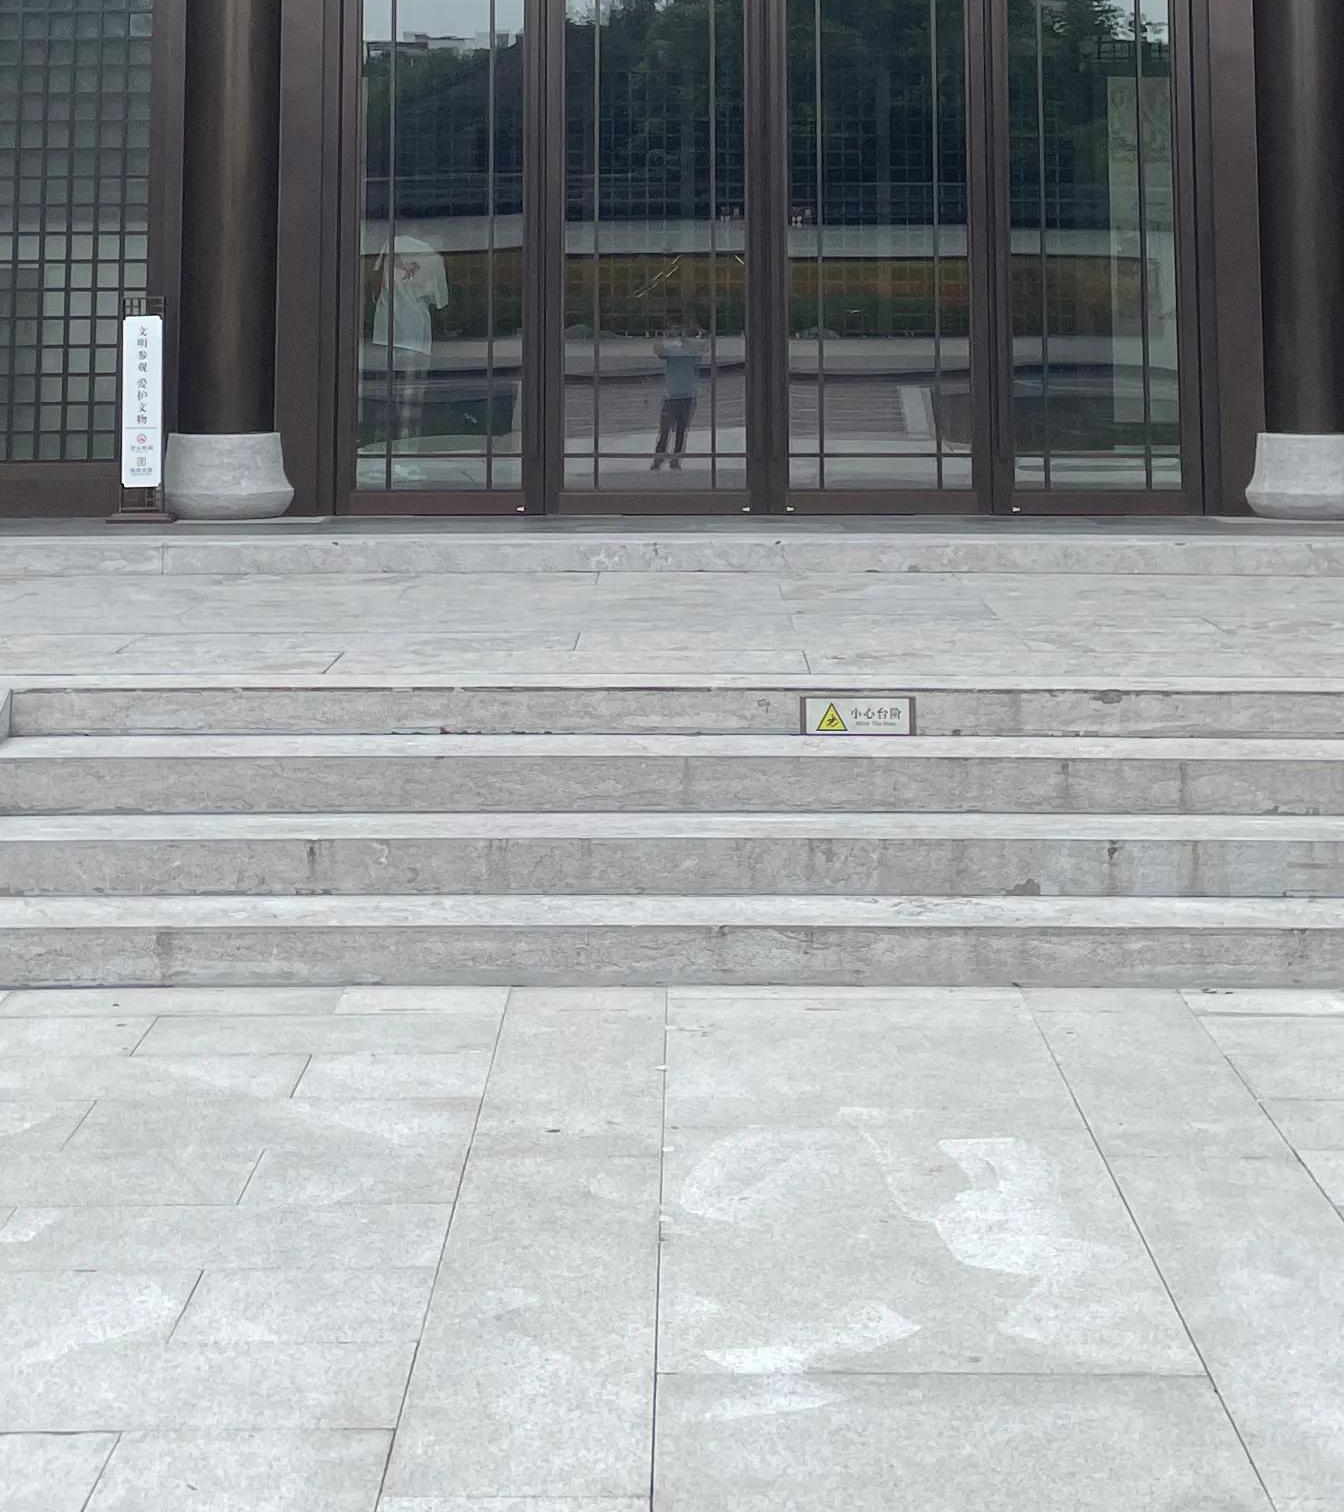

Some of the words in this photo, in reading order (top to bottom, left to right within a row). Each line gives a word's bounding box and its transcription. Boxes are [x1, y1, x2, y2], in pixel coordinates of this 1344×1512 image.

[137, 377, 148, 425] 爱护文物
[851, 708, 902, 719] 小心台阶
